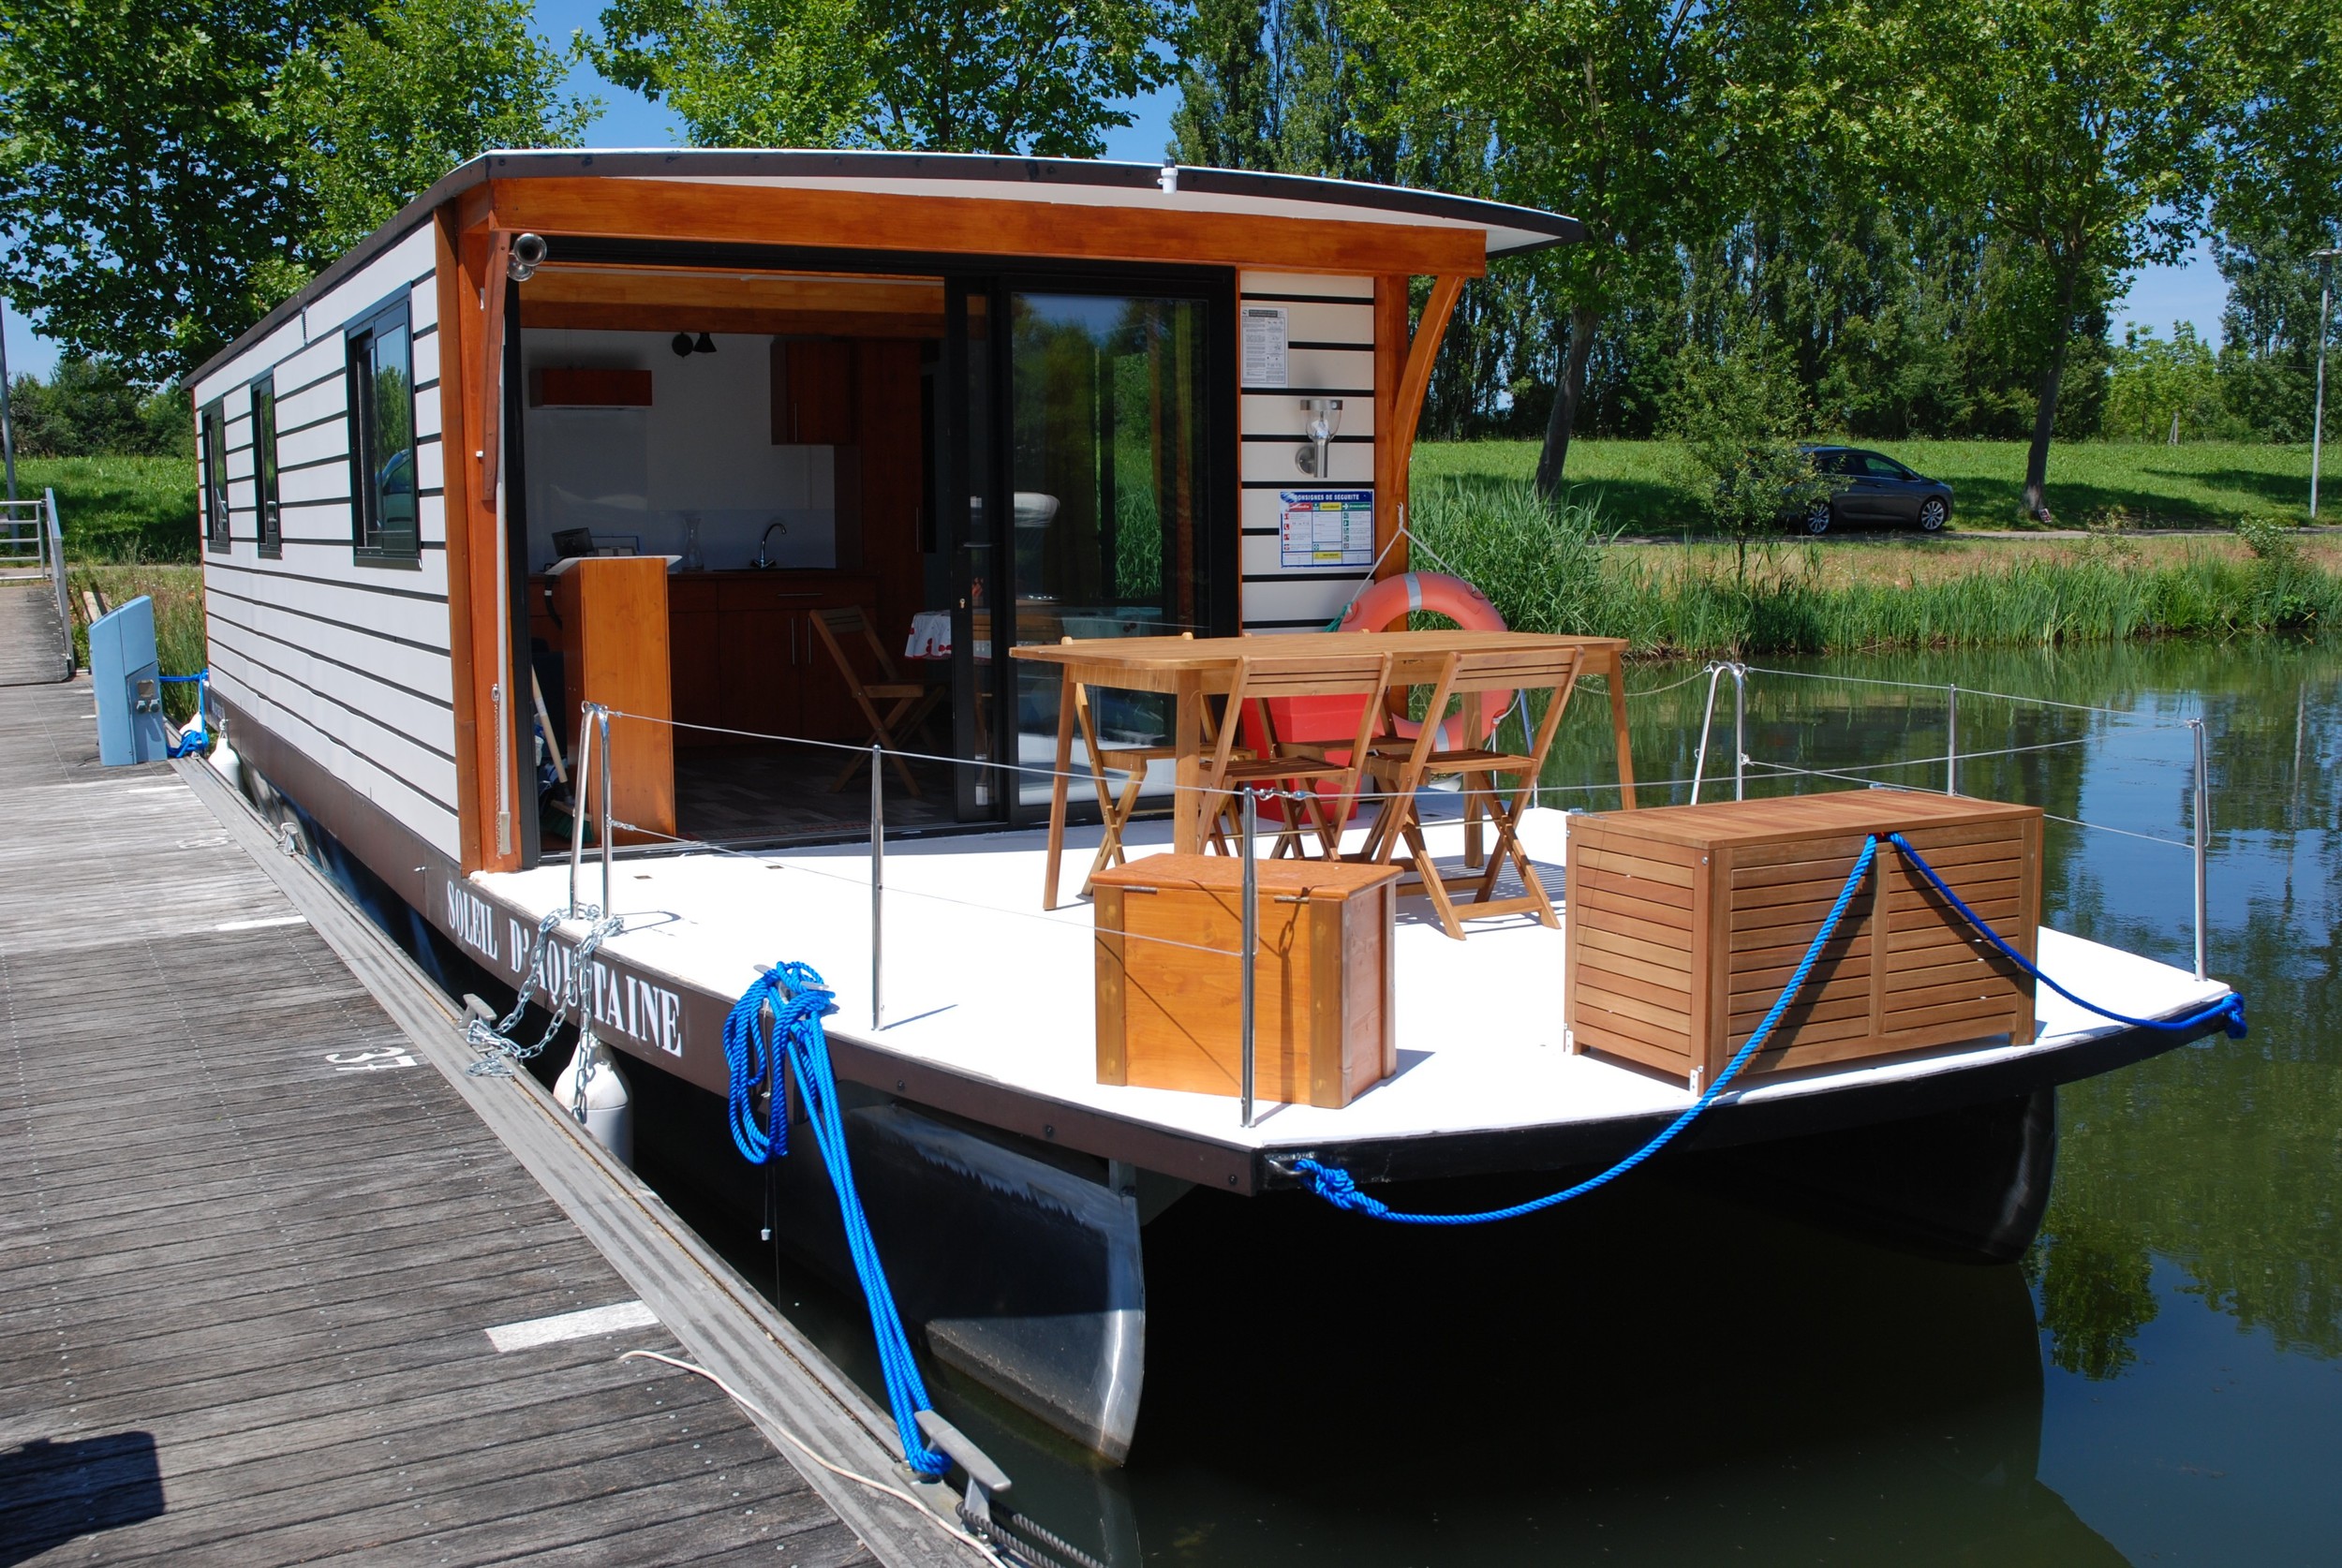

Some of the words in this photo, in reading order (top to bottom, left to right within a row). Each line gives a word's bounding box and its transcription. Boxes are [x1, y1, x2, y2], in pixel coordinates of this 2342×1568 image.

[446, 880, 497, 961] SOLEIL
[509, 918, 683, 1058] D'AQUTAINE
[325, 1046, 417, 1072] 37
